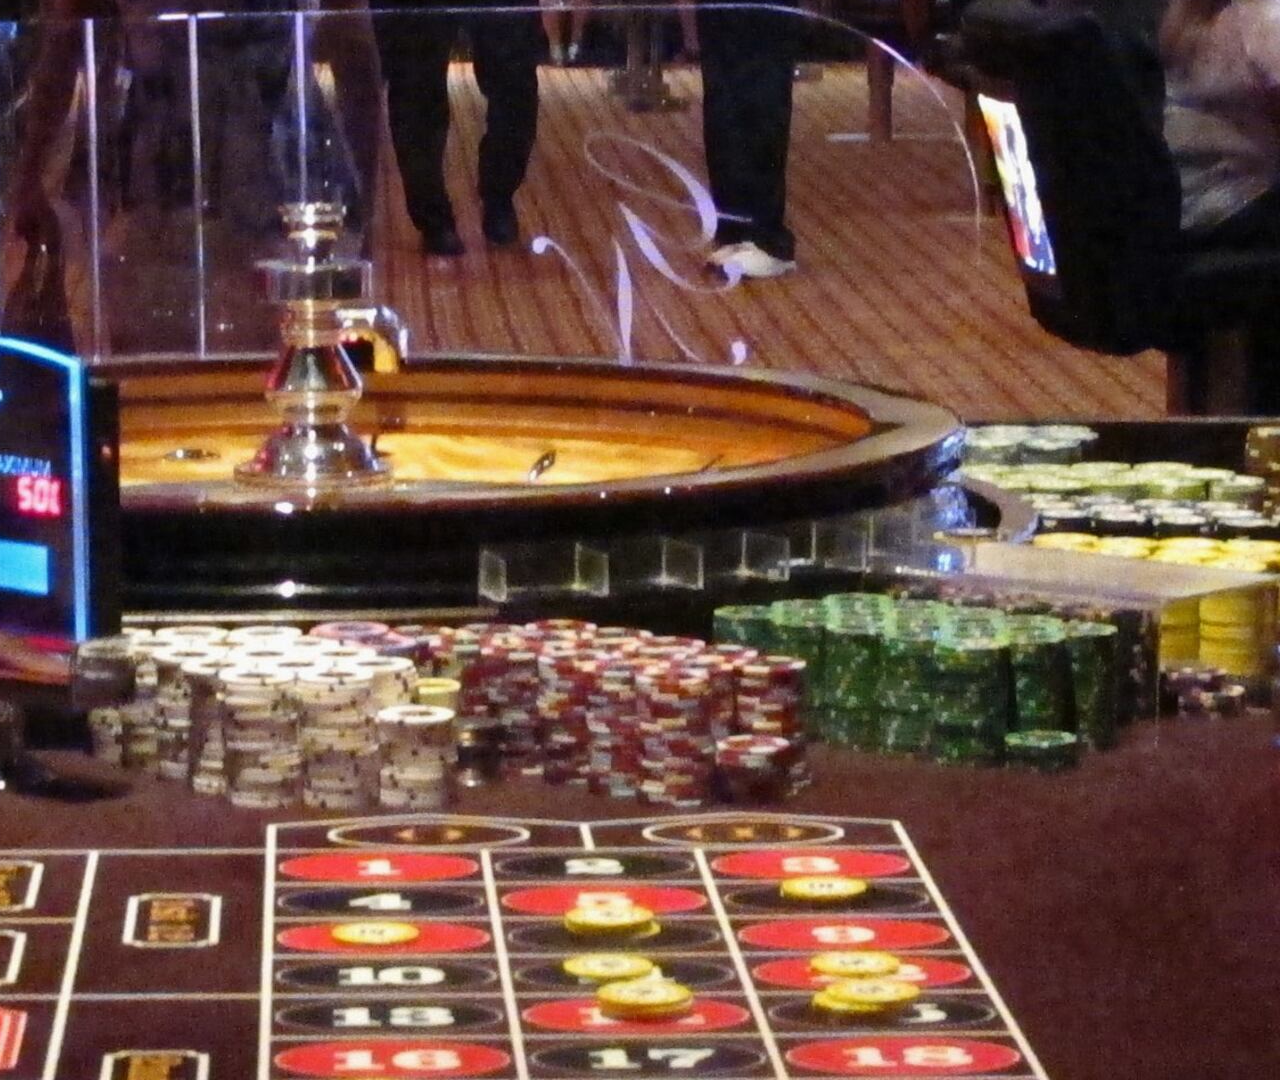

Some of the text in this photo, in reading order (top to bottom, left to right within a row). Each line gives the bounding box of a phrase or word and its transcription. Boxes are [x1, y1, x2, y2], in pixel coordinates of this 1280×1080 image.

[358, 859, 401, 876] 1
[349, 893, 411, 910] 4
[338, 966, 445, 986] 10
[588, 1047, 715, 1070] 17
